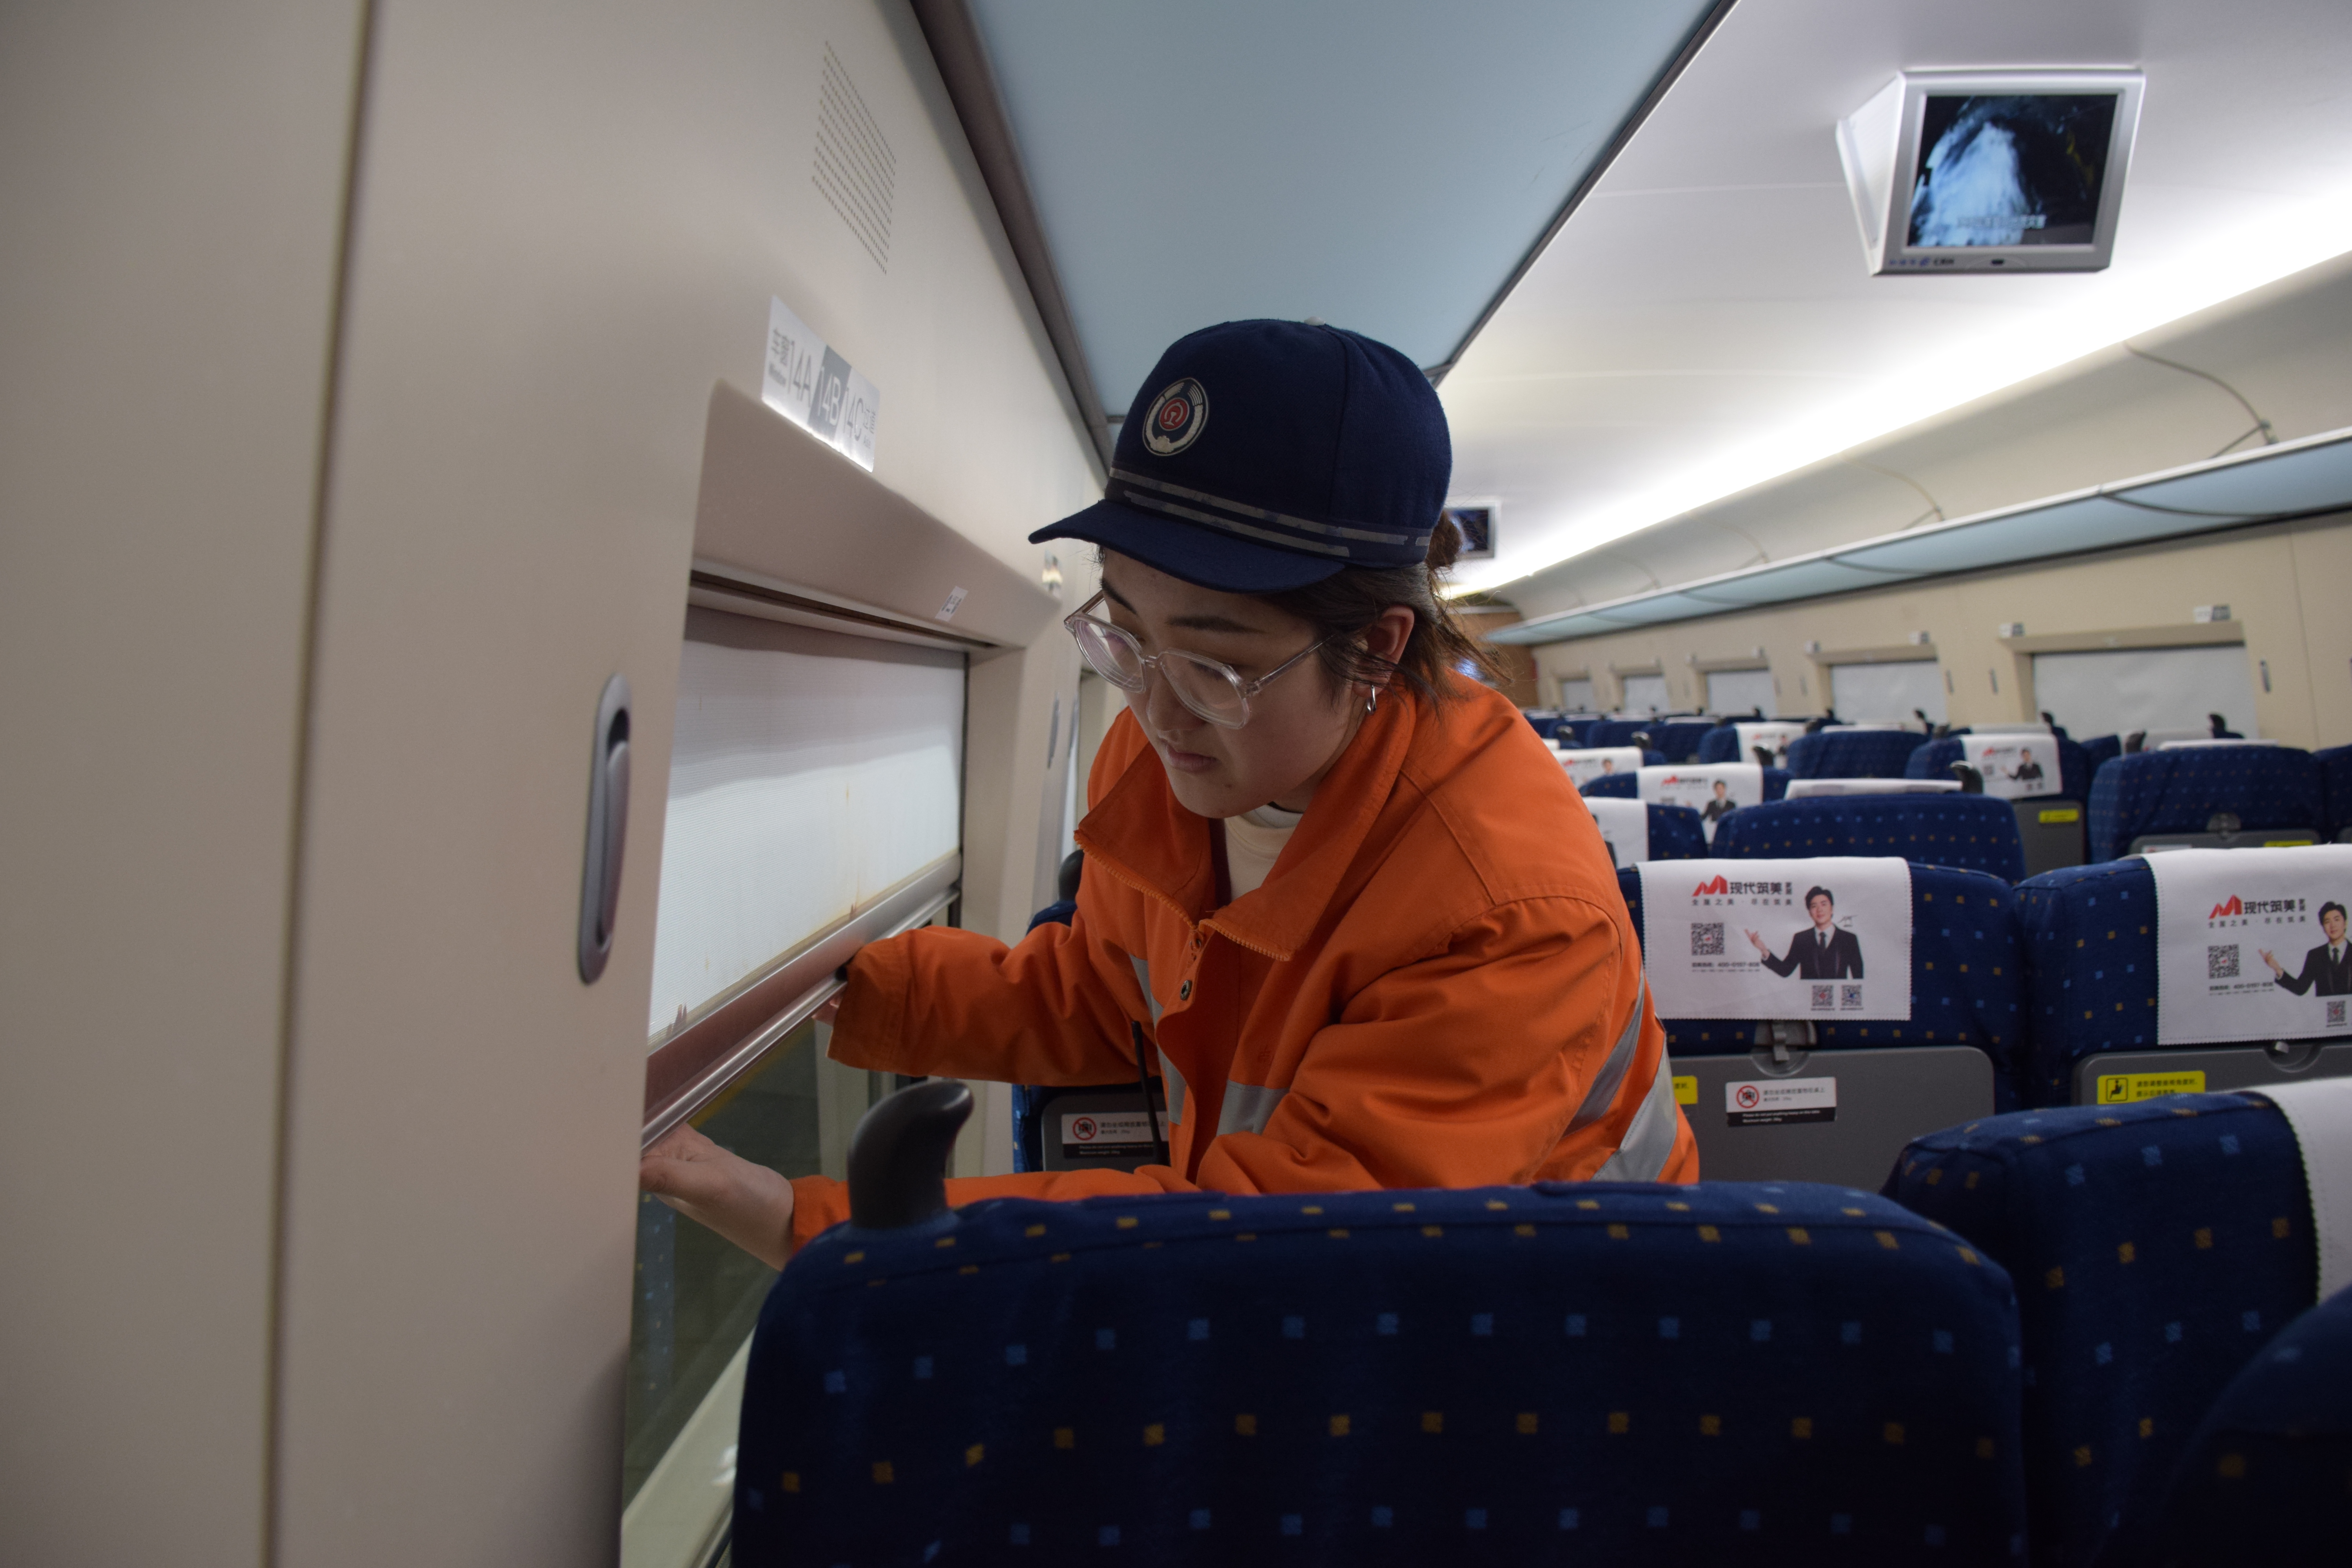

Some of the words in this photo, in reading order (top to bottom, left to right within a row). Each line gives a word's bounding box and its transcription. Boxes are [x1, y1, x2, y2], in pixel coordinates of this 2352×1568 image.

[788, 341, 811, 408] 14A
[818, 366, 842, 426] 14B
[843, 387, 863, 441] 14C
[1730, 882, 1782, 895] 现代筑美
[2244, 899, 2296, 915] 现代筑美
